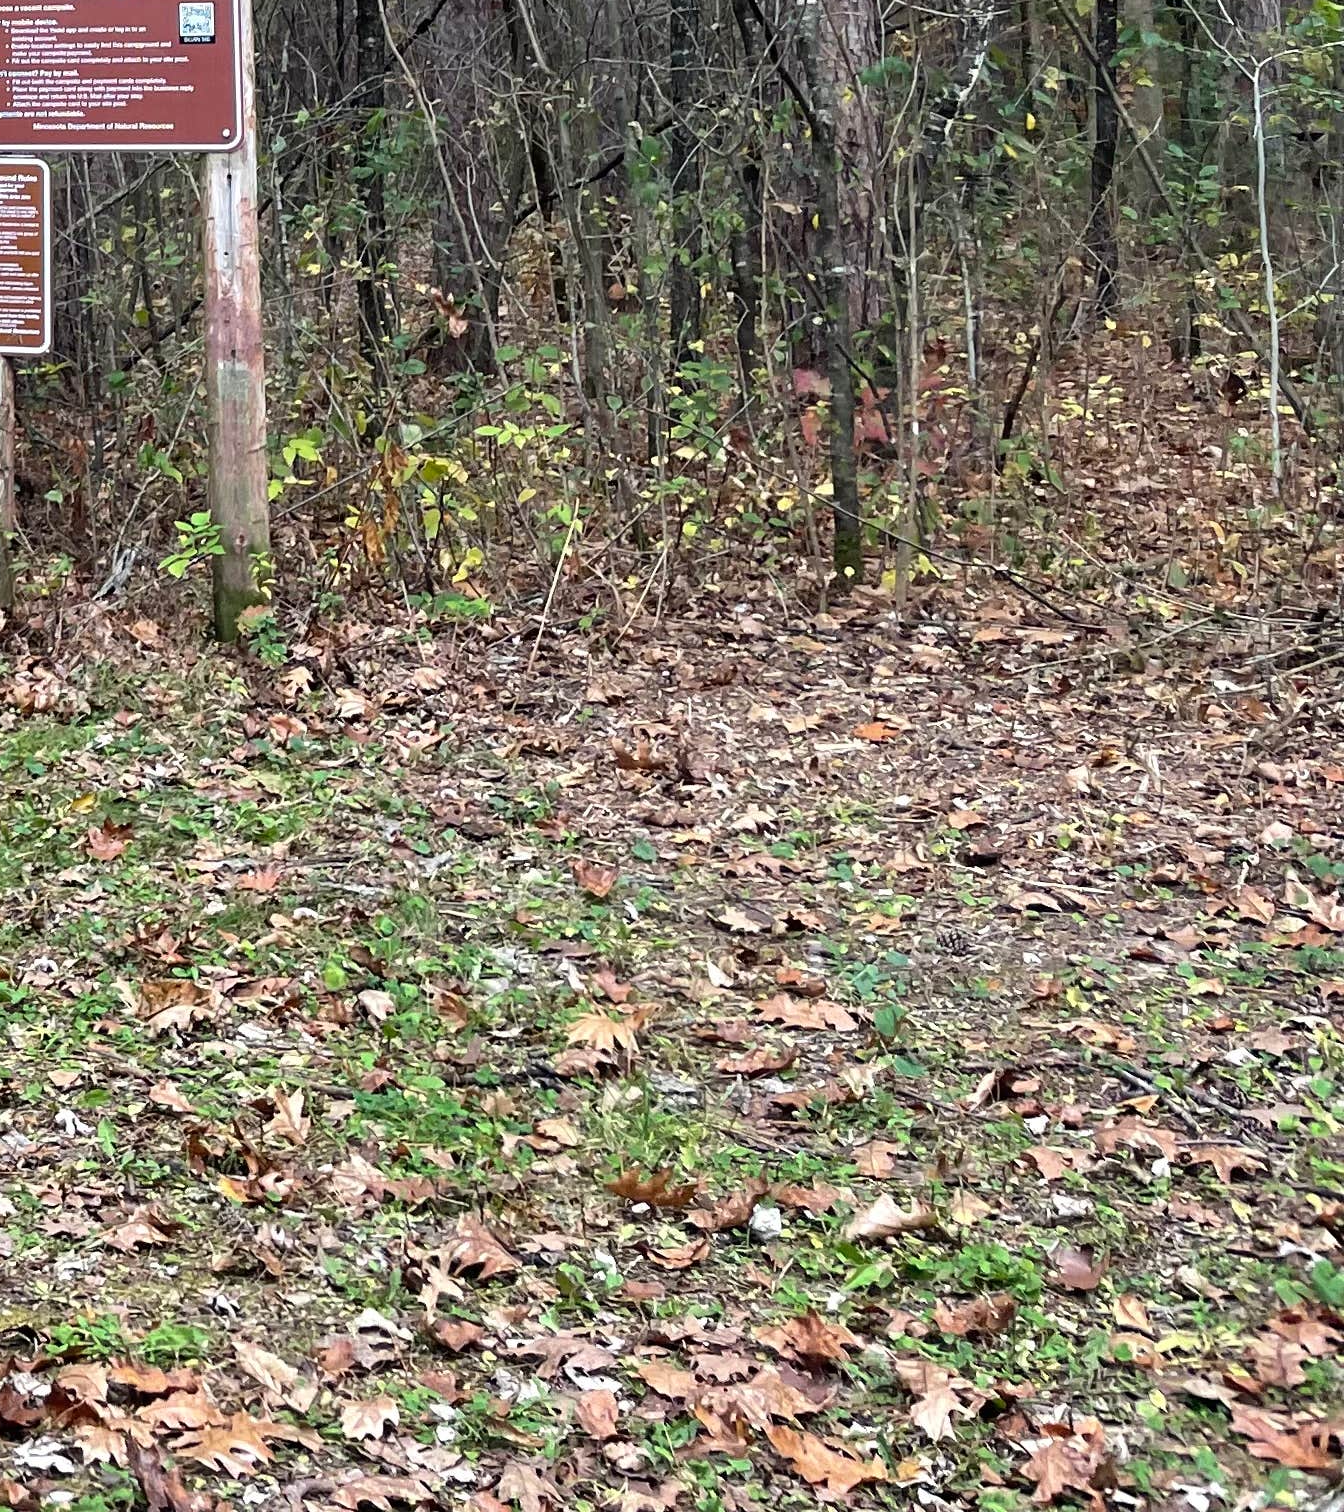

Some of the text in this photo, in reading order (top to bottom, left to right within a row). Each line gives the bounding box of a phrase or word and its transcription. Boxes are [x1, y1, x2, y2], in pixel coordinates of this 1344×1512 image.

[2, 19, 10, 27] by
[11, 18, 34, 26] mobile
[34, 18, 58, 26] device.
[40, 70, 52, 78] Pay
